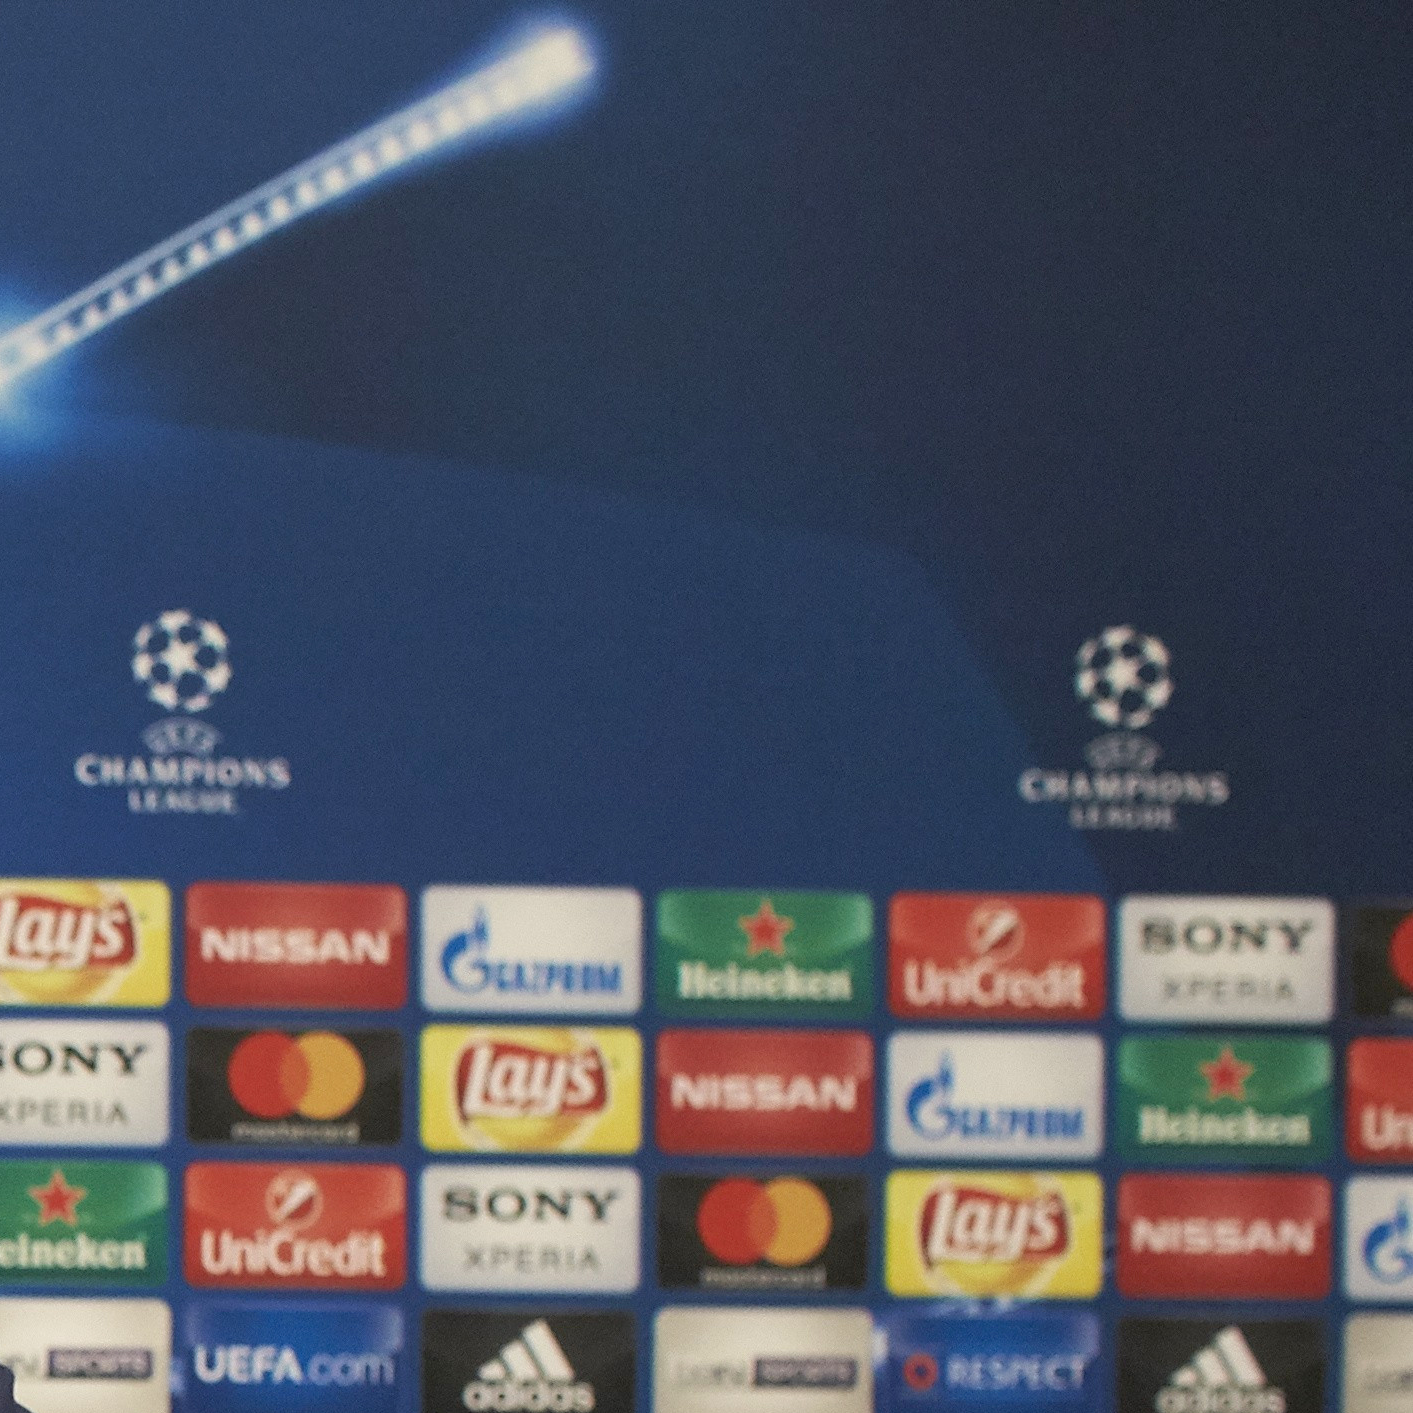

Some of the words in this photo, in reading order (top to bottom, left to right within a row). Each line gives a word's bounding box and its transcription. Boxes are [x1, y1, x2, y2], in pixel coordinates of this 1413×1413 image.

[74, 752, 292, 788] CHAMPIONS
[200, 928, 391, 966] NISSAN
[1139, 916, 1313, 957] SONY
[493, 960, 622, 993] GAZPROM
[677, 961, 854, 1000] Heineken
[903, 958, 1086, 1010] UniCredit
[1161, 972, 1297, 1001] XPERIA
[670, 1073, 858, 1112] NISSAN
[1138, 1106, 1311, 1146] Heineken
[442, 1187, 621, 1224] SONY
[200, 1228, 388, 1279] UniCredit
[1130, 1217, 1315, 1256] NISSAN
[463, 1243, 601, 1274] XPERIA
[194, 1343, 395, 1386] UEFA.com
[945, 1353, 1086, 1391] RESPECT
[463, 1378, 595, 1413] adidas
